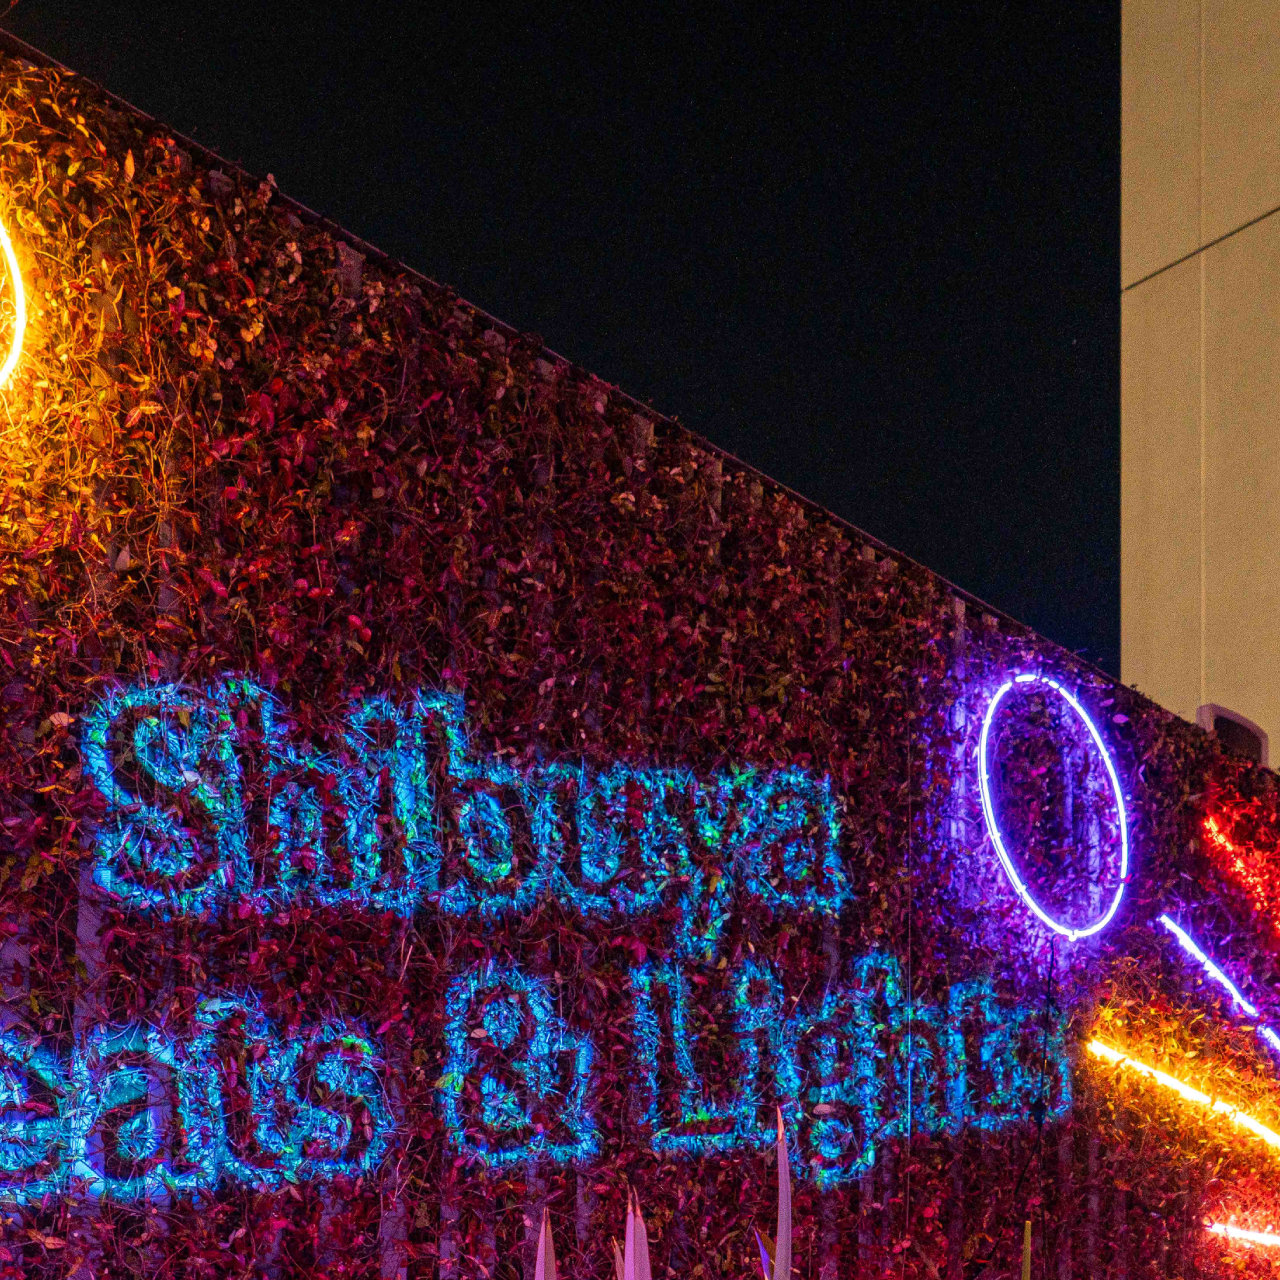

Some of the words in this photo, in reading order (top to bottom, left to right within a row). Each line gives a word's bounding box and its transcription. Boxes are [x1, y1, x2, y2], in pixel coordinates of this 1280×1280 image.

[81, 676, 850, 962] Shibuya
[442, 958, 598, 1166] &
[630, 952, 1070, 1188] Lights
